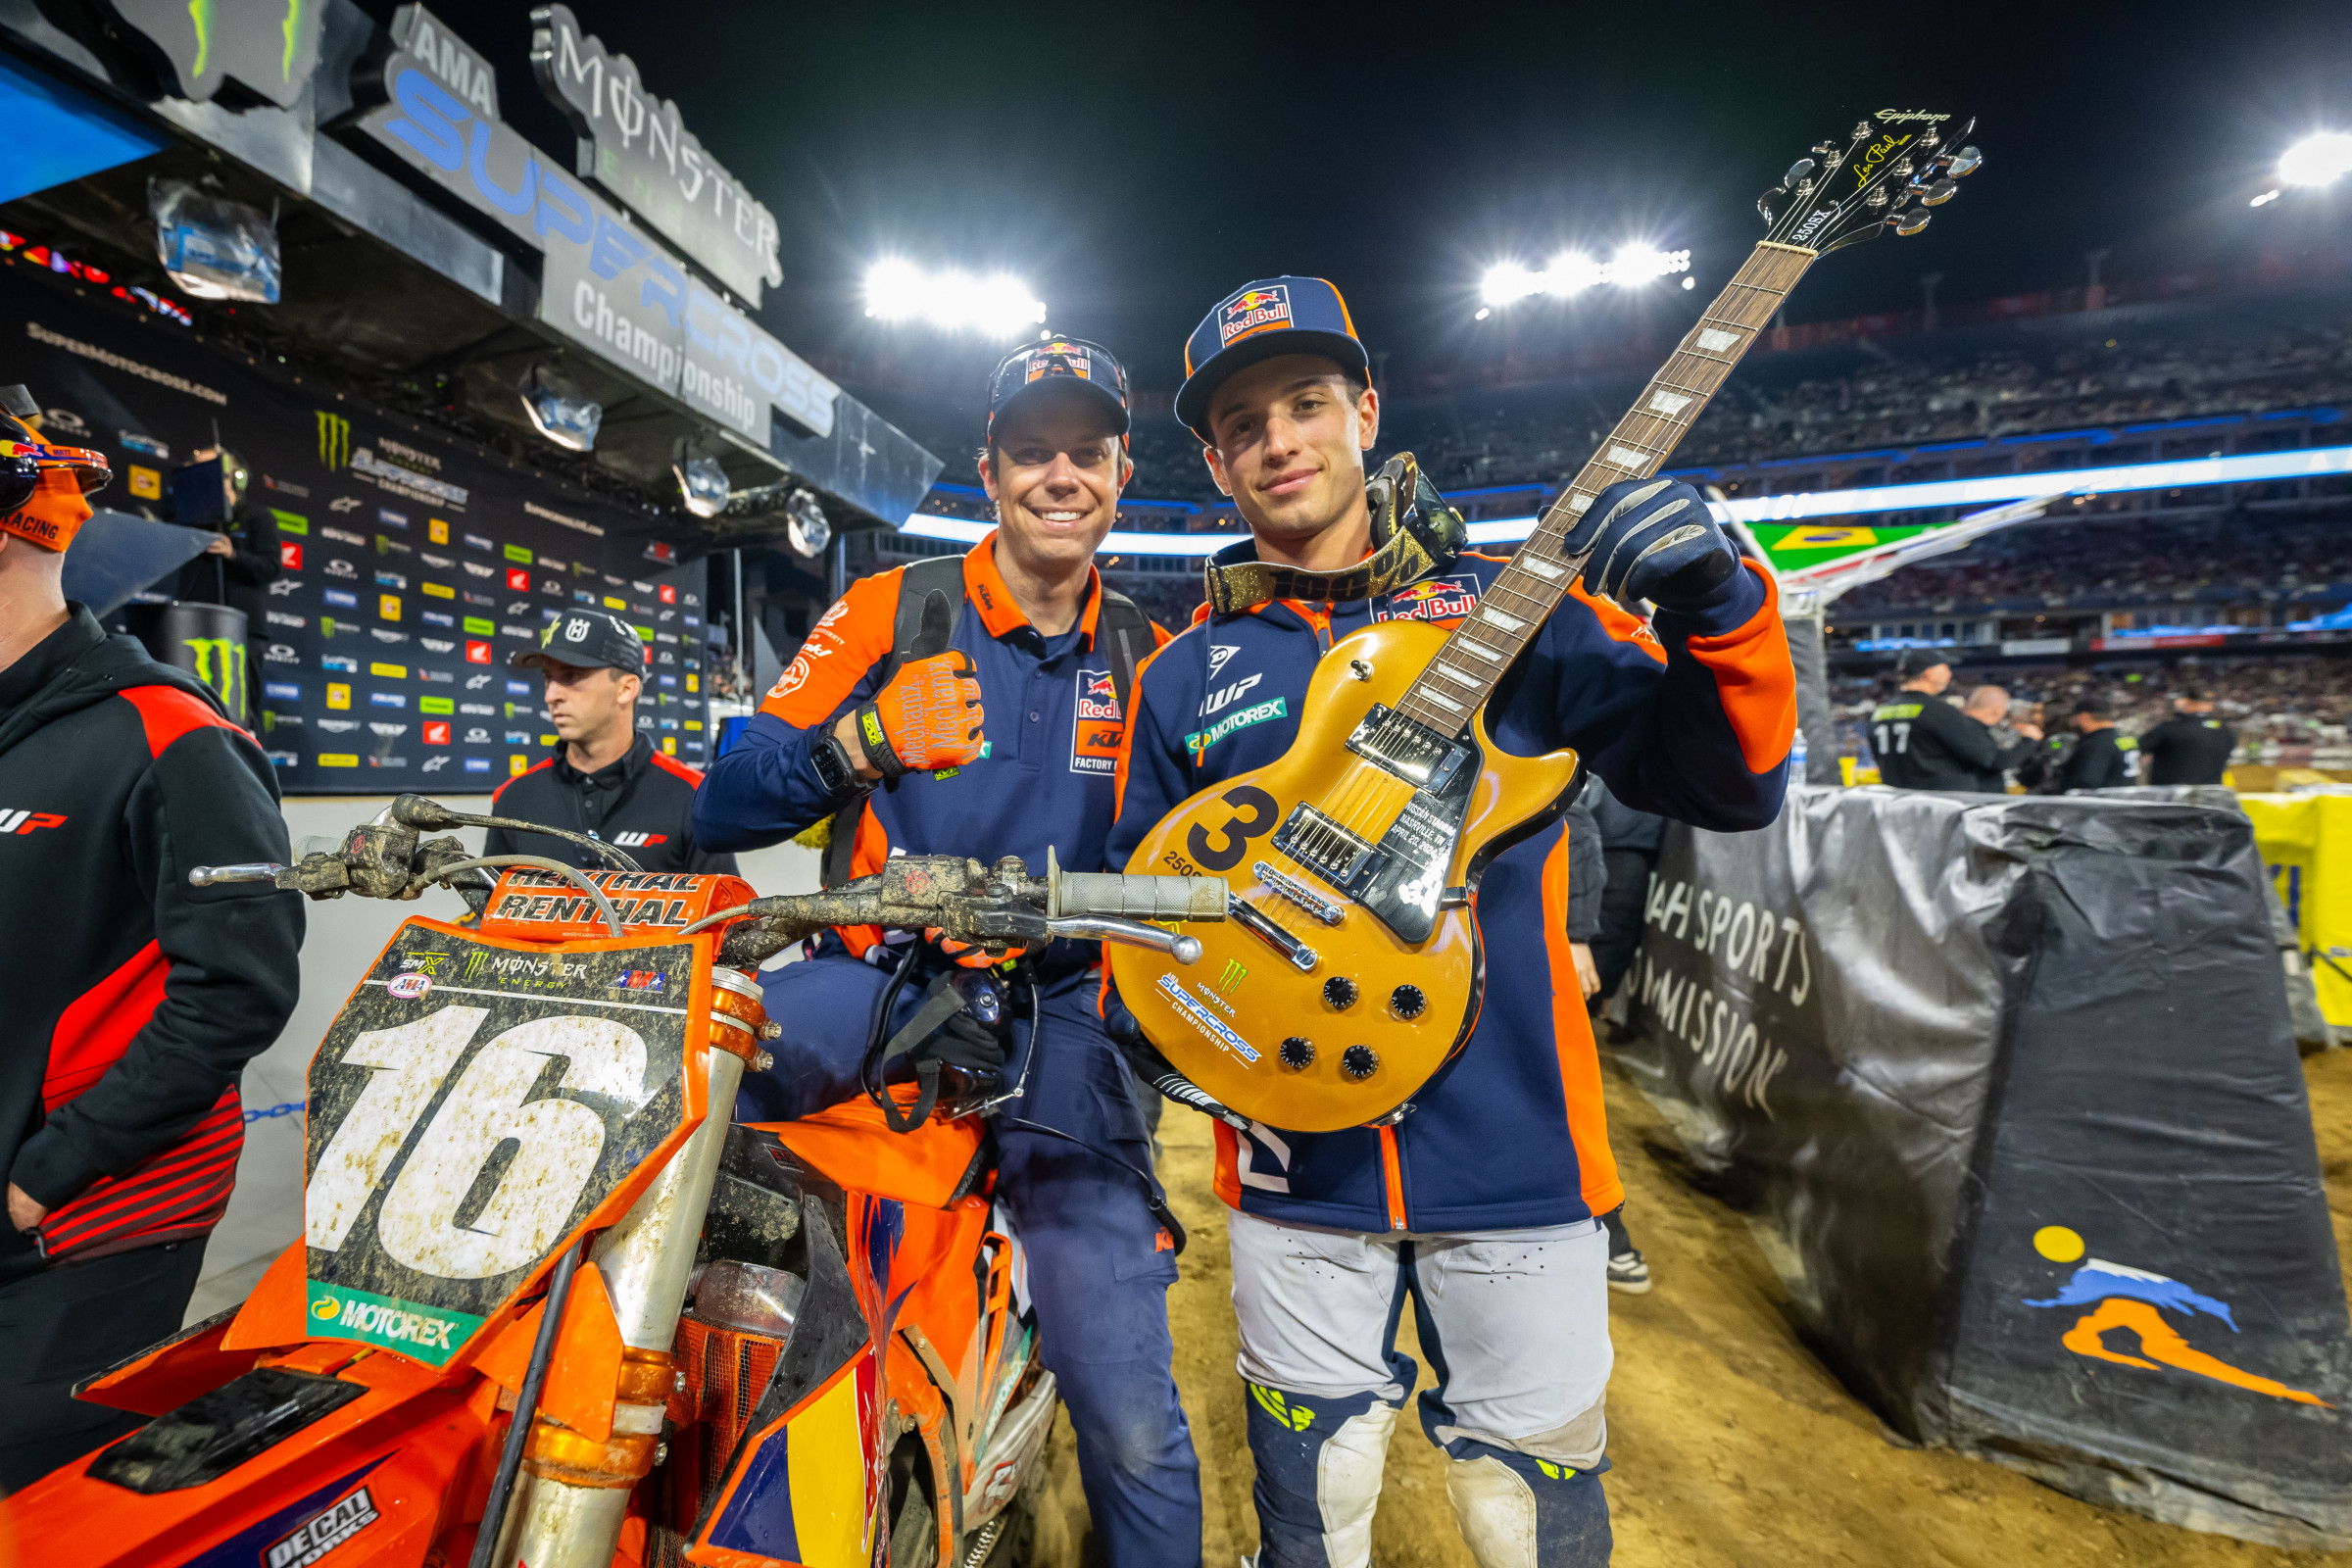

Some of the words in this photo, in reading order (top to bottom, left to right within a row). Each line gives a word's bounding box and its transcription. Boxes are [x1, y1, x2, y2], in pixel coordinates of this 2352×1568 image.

[416, 25, 491, 117] AMA
[1874, 108, 1951, 126] Epiphone
[560, 24, 780, 280] MONSTER
[1791, 209, 1832, 242] 250SX
[384, 69, 840, 436] SUPERCROSS
[1223, 311, 1254, 340] Red
[1253, 303, 1289, 323] Bull
[573, 279, 757, 431] Championship
[1029, 360, 1049, 372] Re
[1269, 534, 1419, 602] 100%
[1429, 595, 1477, 618] Bull
[895, 680, 926, 764] Mechanix
[924, 662, 959, 750] Mechanix
[1079, 699, 1116, 718] Red
[1210, 700, 1283, 743] MOTOREX
[1075, 758, 1112, 771] FACTORY
[1187, 785, 1280, 872] 3
[1390, 824, 1410, 841] APRIL
[492, 894, 690, 926] RENTHAL
[399, 956, 445, 975] SMX
[1694, 889, 1811, 1006] SPORTS
[394, 978, 425, 991] AMA
[500, 977, 567, 990] ENERGY
[1197, 982, 1237, 1018] MONSTER
[1156, 975, 1262, 1062] SUPERCROSS
[1171, 1001, 1230, 1053] CHAMPIONSHIP
[306, 1004, 648, 1279] 16
[339, 1299, 456, 1350] MOTOREX
[268, 1495, 368, 1568] DECAL
